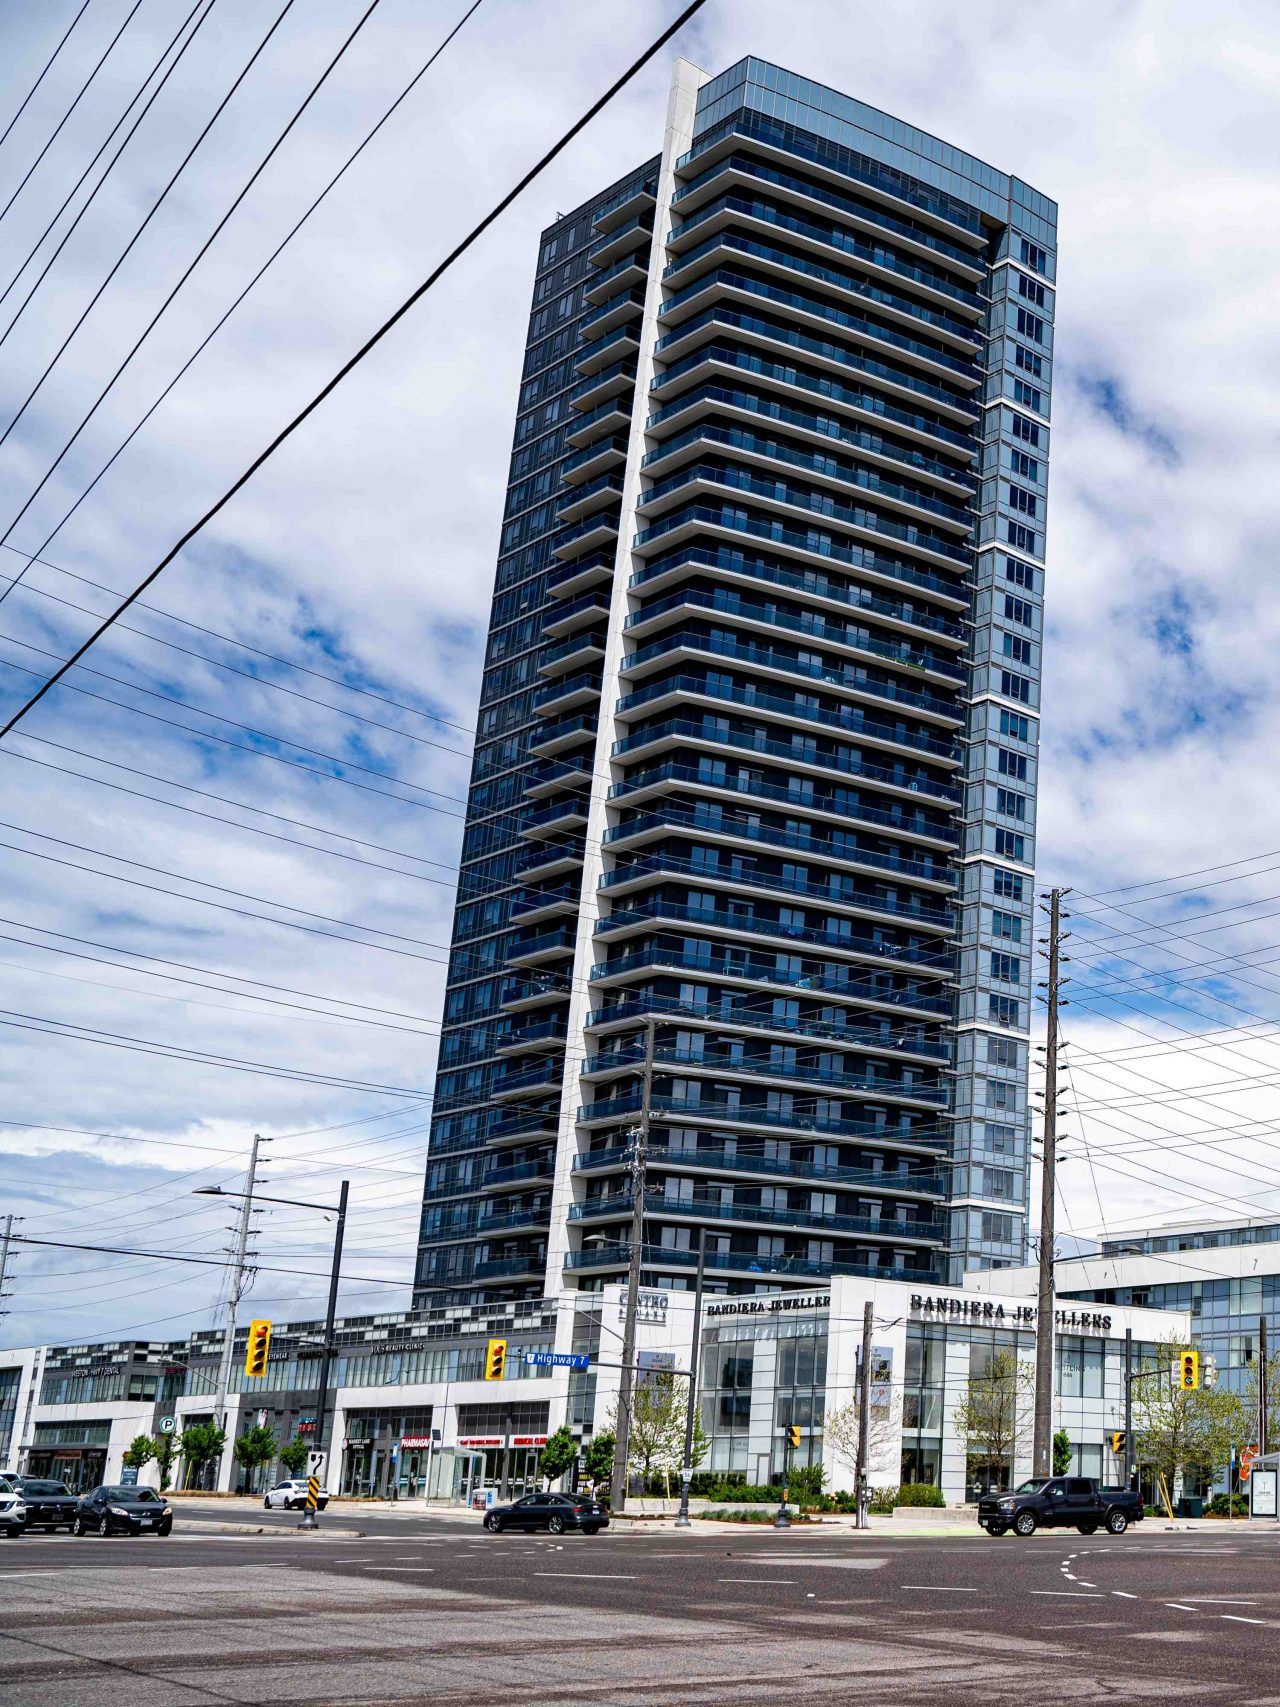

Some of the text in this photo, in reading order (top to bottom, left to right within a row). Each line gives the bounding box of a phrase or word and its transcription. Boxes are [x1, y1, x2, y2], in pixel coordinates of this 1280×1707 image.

[707, 1295, 831, 1317] BANDIERA JEWELLER
[909, 1294, 1112, 1330] BANDIERA JEELLERS
[537, 1354, 577, 1366] Highway
[580, 1356, 585, 1365] 7
